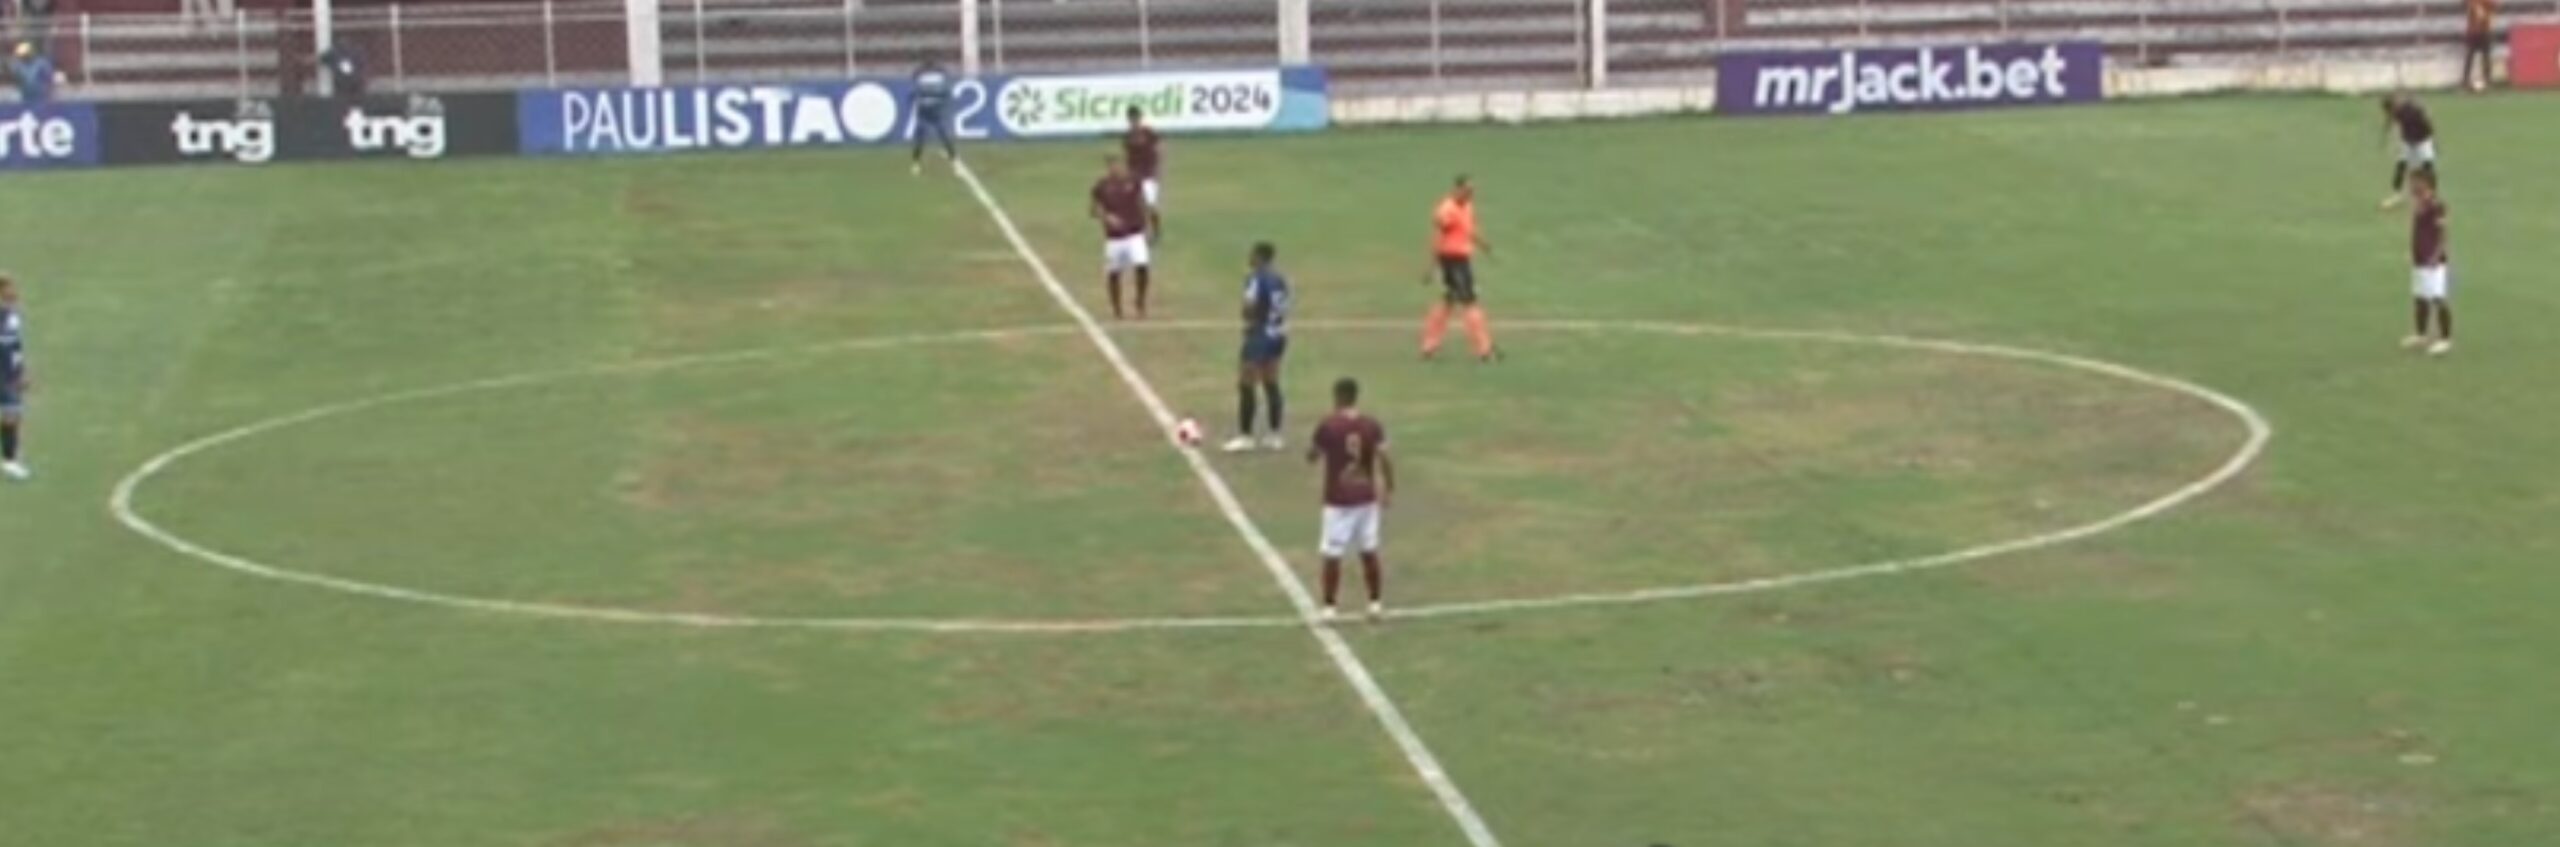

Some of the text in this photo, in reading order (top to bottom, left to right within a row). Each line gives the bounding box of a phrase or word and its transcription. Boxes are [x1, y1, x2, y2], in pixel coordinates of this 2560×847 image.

[1191, 83, 1271, 114] 2024
[1754, 45, 2067, 114] mrJack.bet
[172, 110, 275, 162] tng
[344, 107, 447, 157] tng
